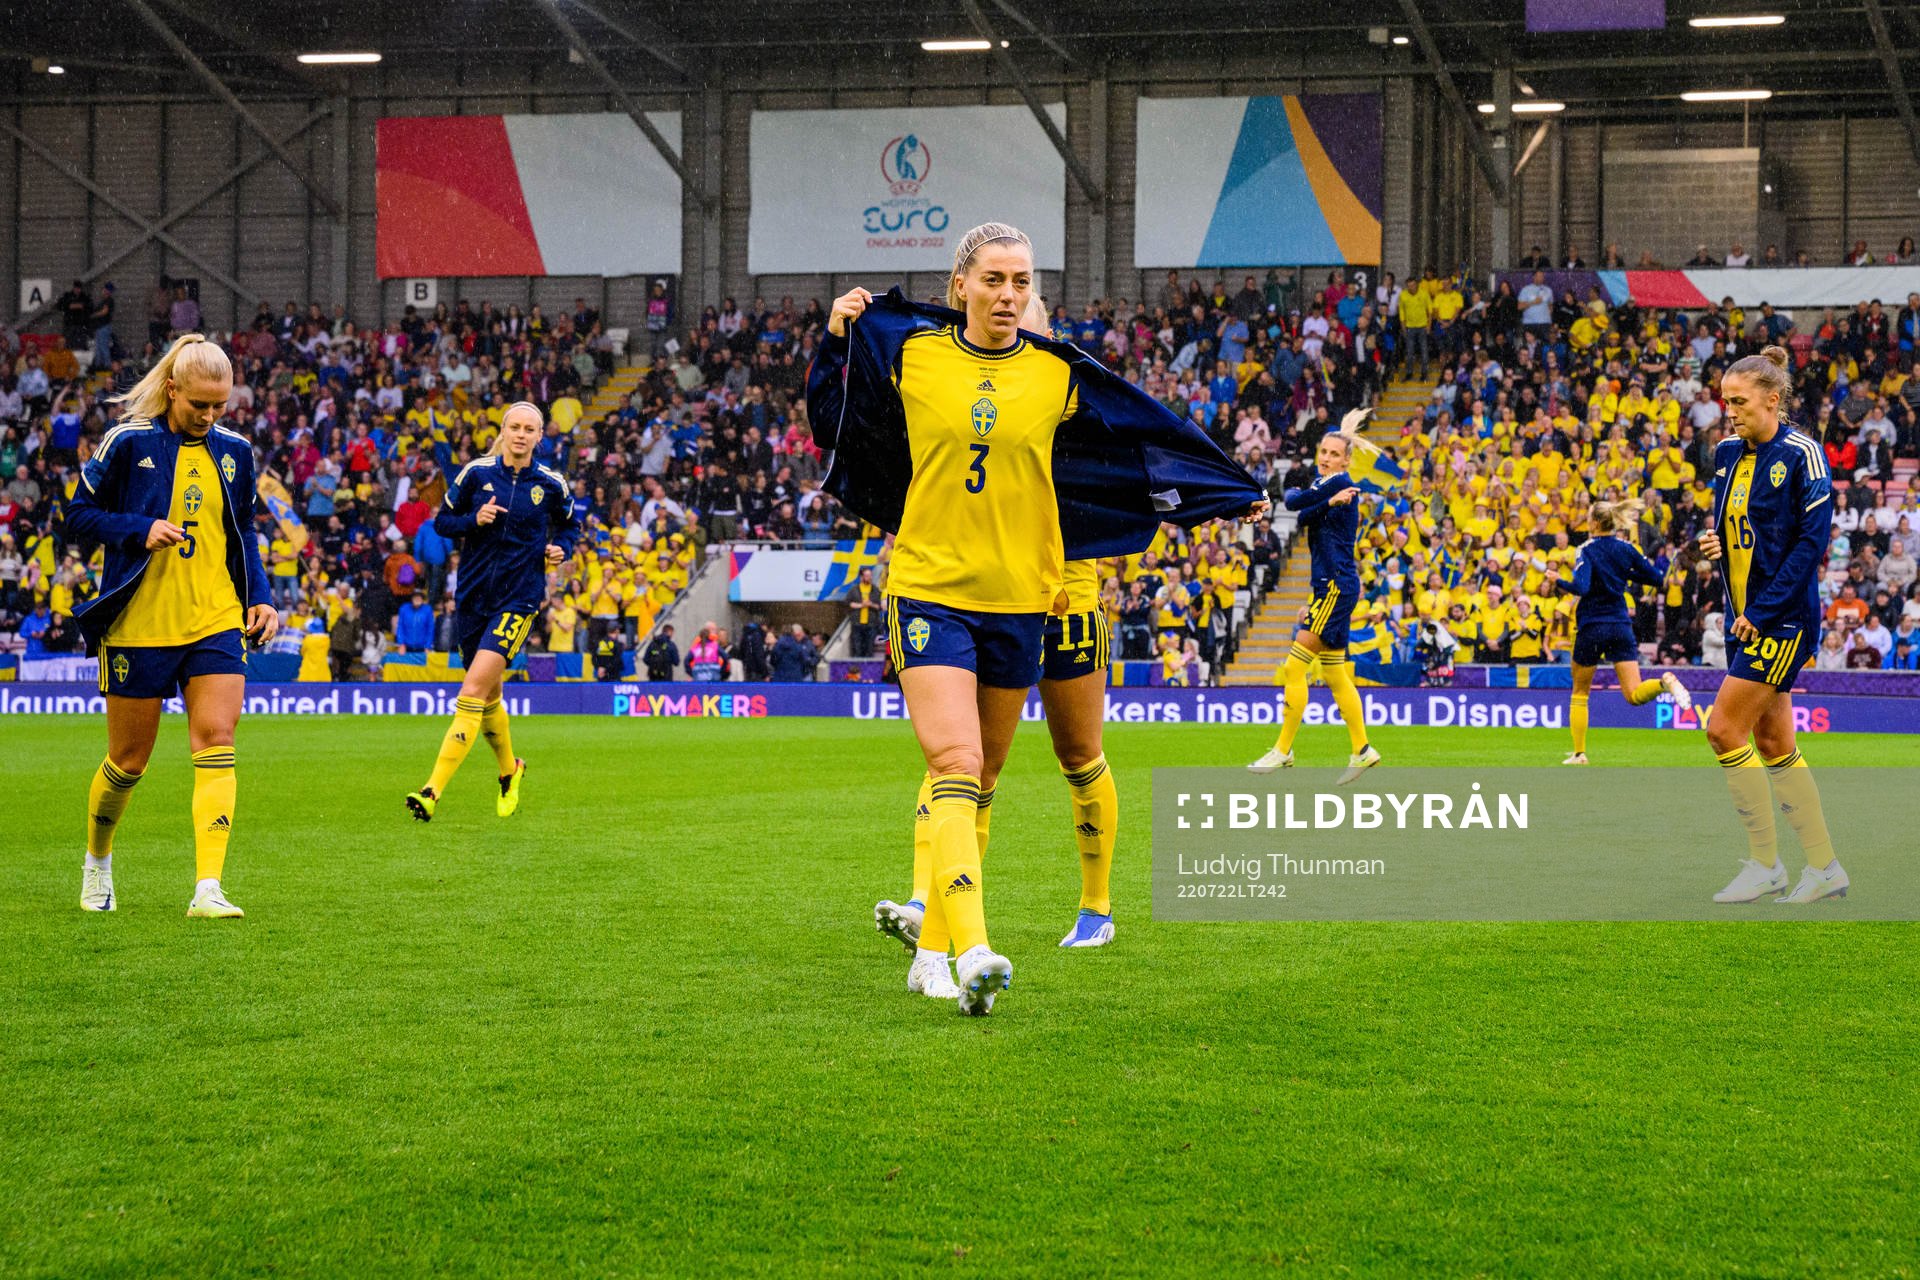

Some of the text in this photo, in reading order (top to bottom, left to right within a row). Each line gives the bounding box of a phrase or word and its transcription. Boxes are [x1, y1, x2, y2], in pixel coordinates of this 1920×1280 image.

[866, 237, 945, 248] ENGLAND 2022
[415, 283, 428, 300] B
[1354, 271, 1368, 291] 3
[29, 287, 45, 306] A
[965, 443, 990, 494] 3
[179, 521, 199, 559] 5
[1729, 514, 1755, 550] 16
[804, 570, 819, 582] E1
[492, 612, 524, 641] 13
[1057, 612, 1094, 651] 11
[613, 684, 640, 694] UEFA
[613, 695, 768, 718] PLAYMAKERS
